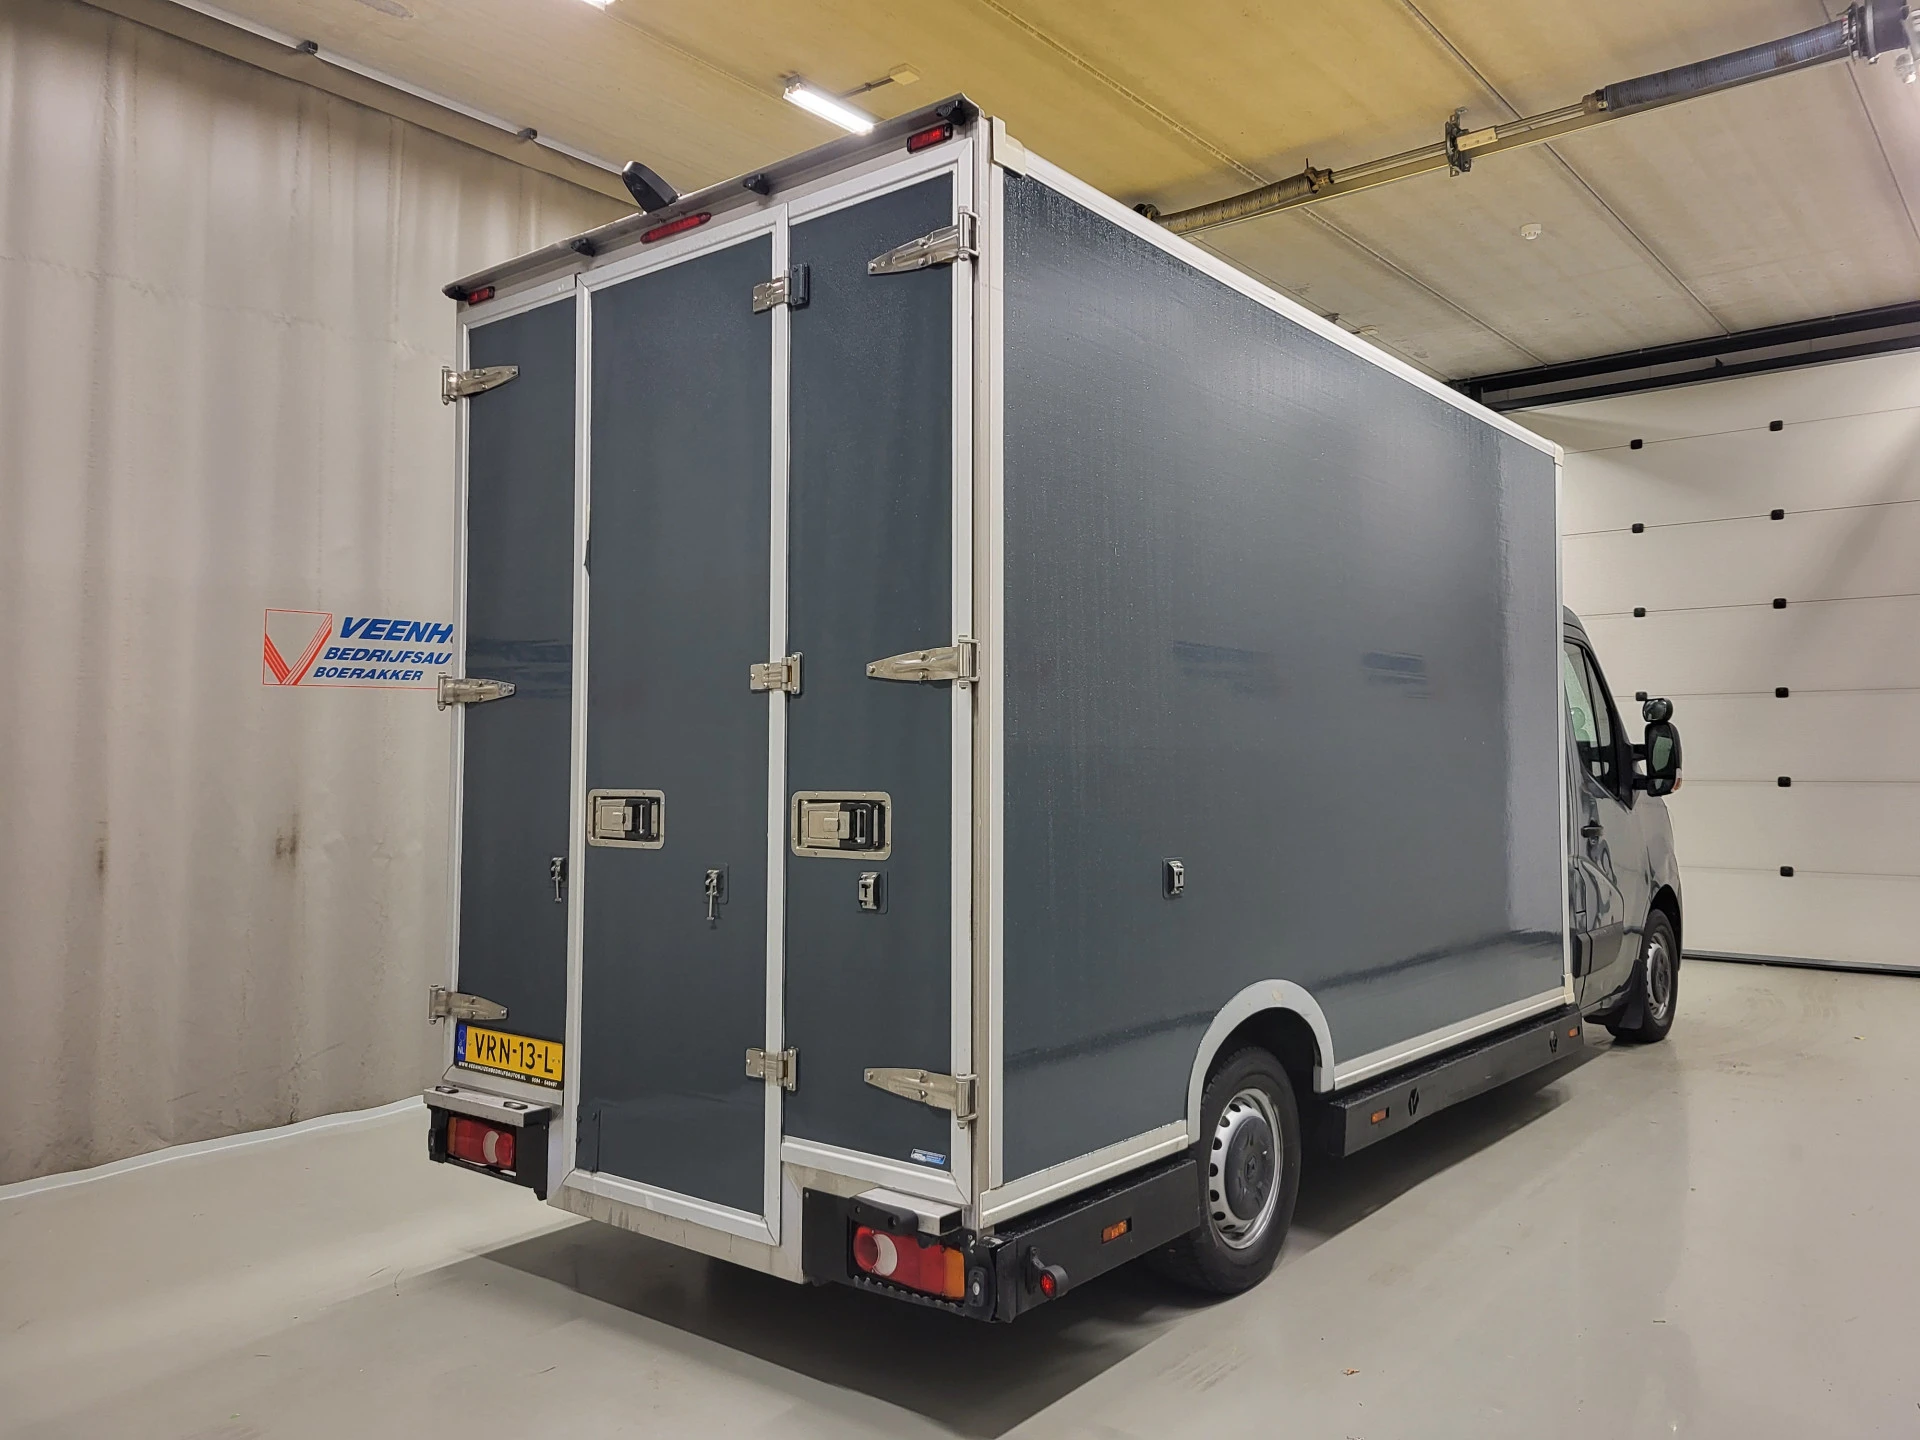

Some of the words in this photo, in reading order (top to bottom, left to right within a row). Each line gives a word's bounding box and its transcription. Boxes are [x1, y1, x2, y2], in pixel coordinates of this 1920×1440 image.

[340, 617, 453, 643] VEENH
[324, 647, 452, 664] BEDRIJFSAU
[313, 667, 423, 680] BOERAKKER
[457, 1046, 465, 1055] NL
[475, 1033, 553, 1073] VRN-13-L
